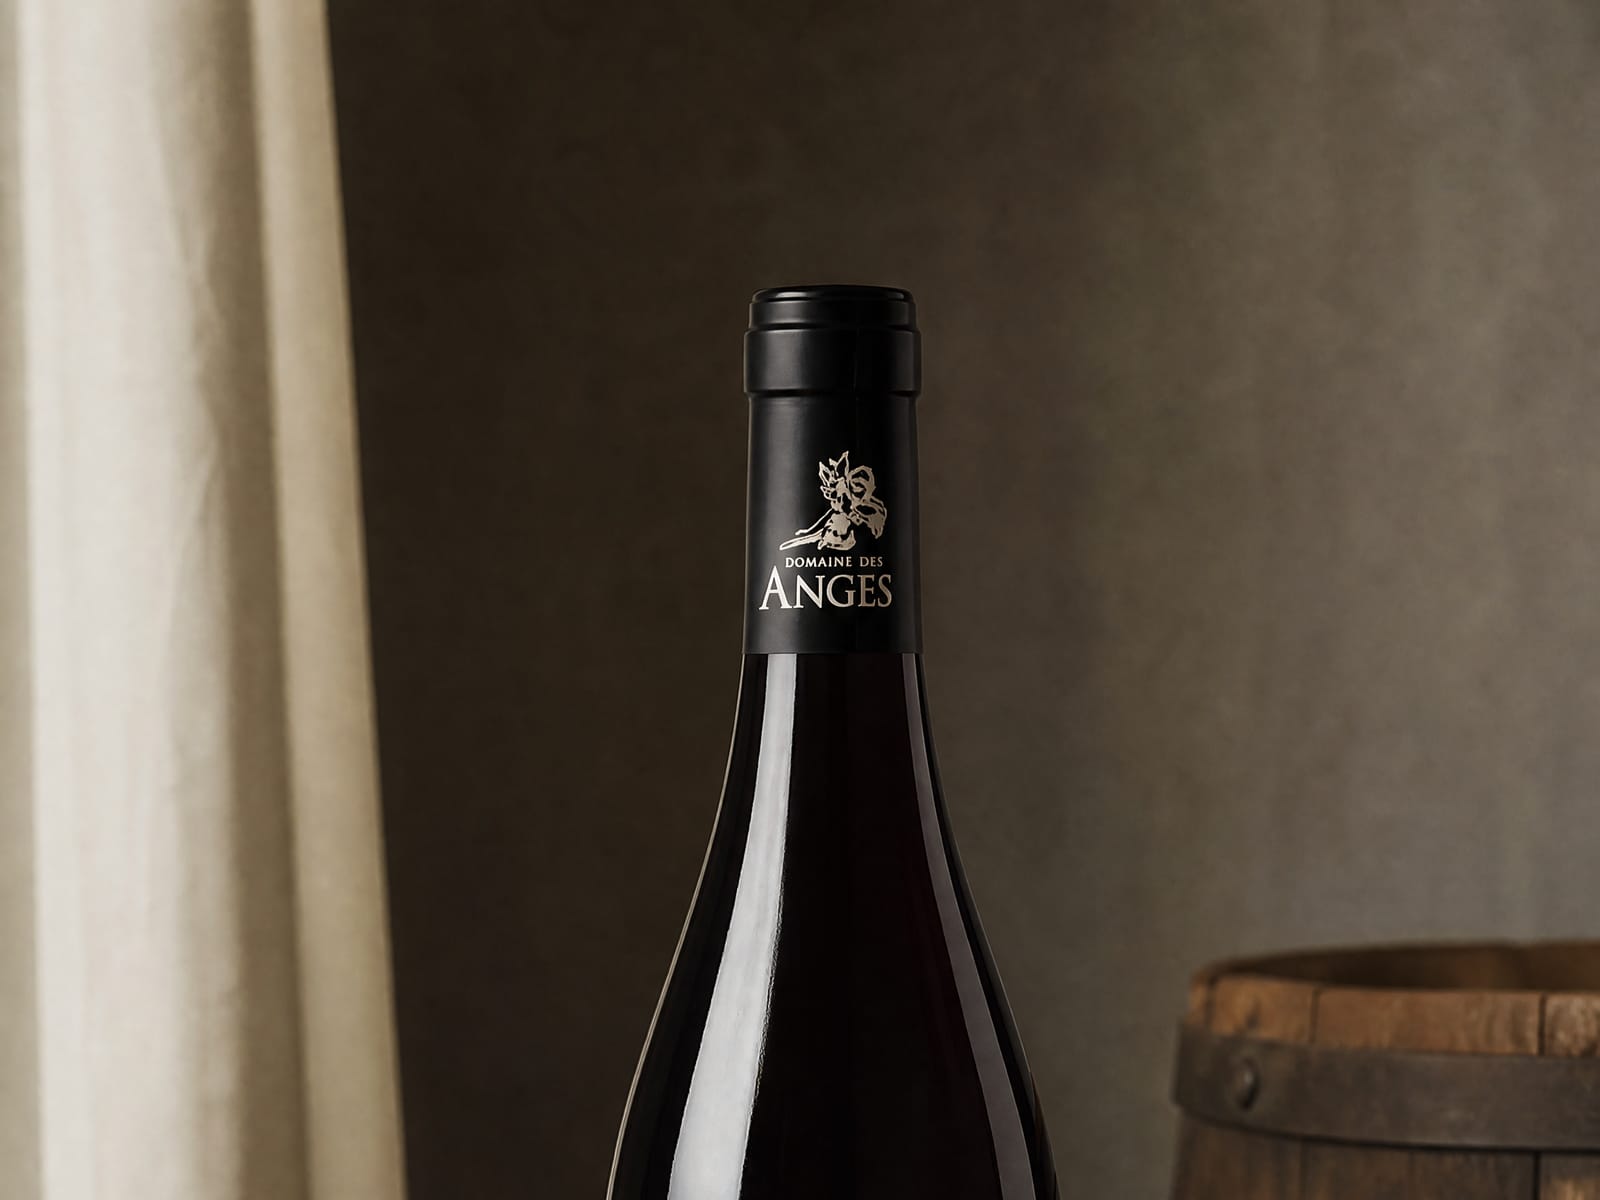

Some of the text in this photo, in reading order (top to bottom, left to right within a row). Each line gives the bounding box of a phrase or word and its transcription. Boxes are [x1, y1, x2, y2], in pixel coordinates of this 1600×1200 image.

[785, 556, 883, 568] DOMAINE DES
[759, 566, 892, 610] ANGES
